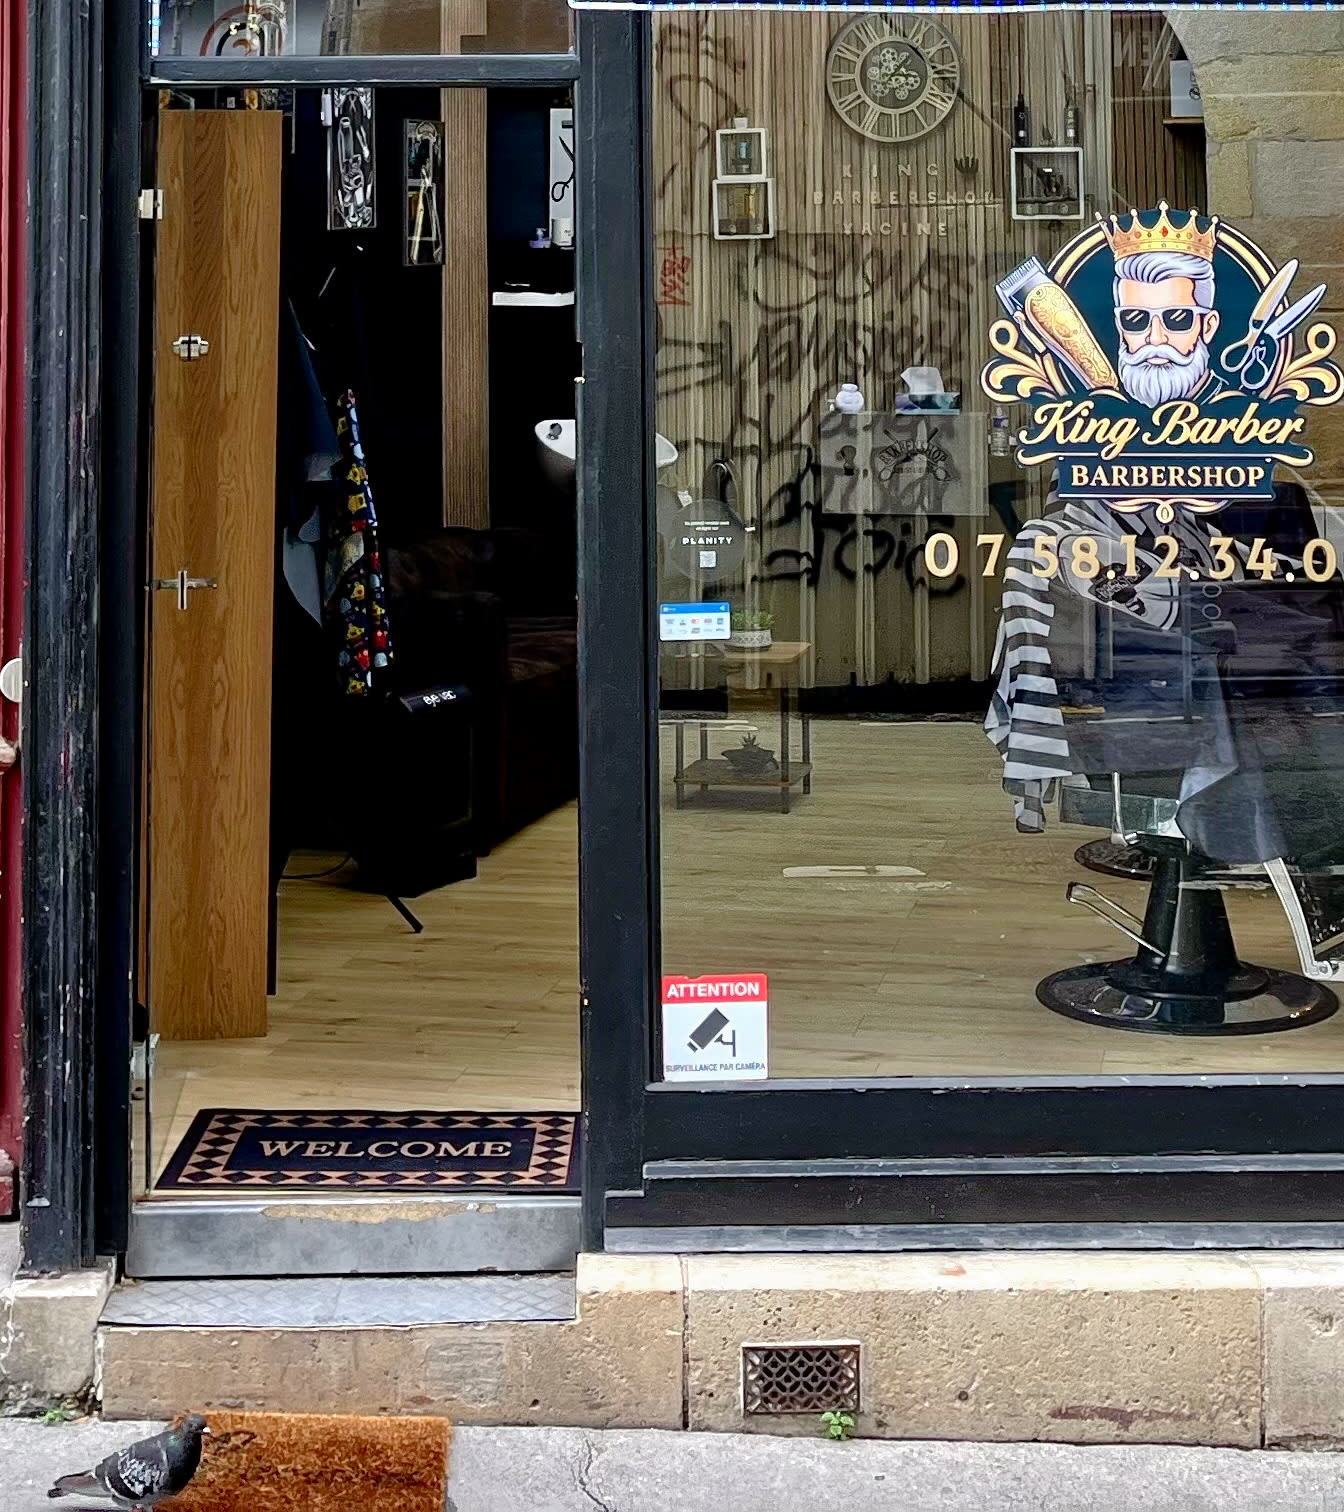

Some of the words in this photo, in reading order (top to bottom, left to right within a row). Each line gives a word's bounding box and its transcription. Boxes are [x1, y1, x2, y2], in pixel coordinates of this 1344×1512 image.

[1018, 400, 1141, 461] King
[1142, 400, 1305, 446] Barber
[1070, 464, 1265, 488] BARBERSHOP
[682, 536, 733, 545] PLANITY
[666, 981, 760, 999] ATTENTION
[665, 1064, 718, 1073] SURVEILLANCE
[719, 1063, 734, 1071] PAR
[258, 1139, 512, 1159] WELCOME
